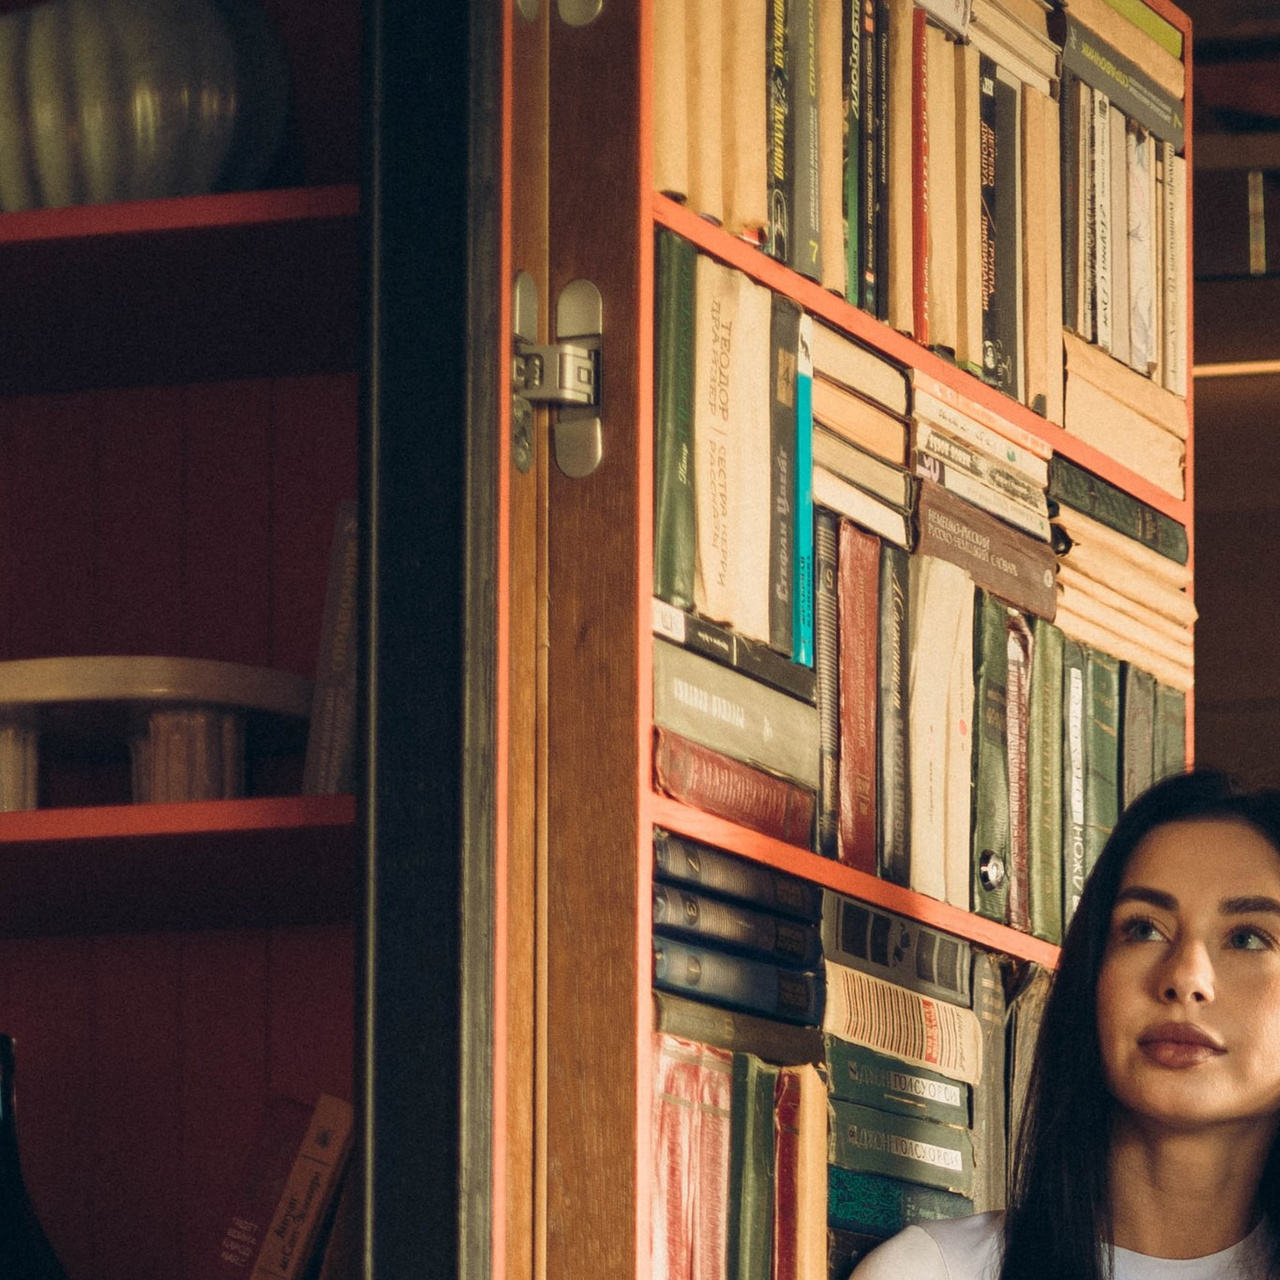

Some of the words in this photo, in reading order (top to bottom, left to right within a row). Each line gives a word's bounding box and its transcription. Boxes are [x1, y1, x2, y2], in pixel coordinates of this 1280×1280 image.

[981, 120, 989, 186] ДЖОШУА
[981, 215, 989, 311] ЛИКВИДАЦИИ
[708, 299, 721, 417] ДРАЙЗЕР
[718, 320, 733, 421] ТЕОДОР
[708, 439, 719, 550] РАССКАЗЫ
[718, 445, 728, 517] СЕСТРА
[715, 523, 729, 587] КЕРРИ
